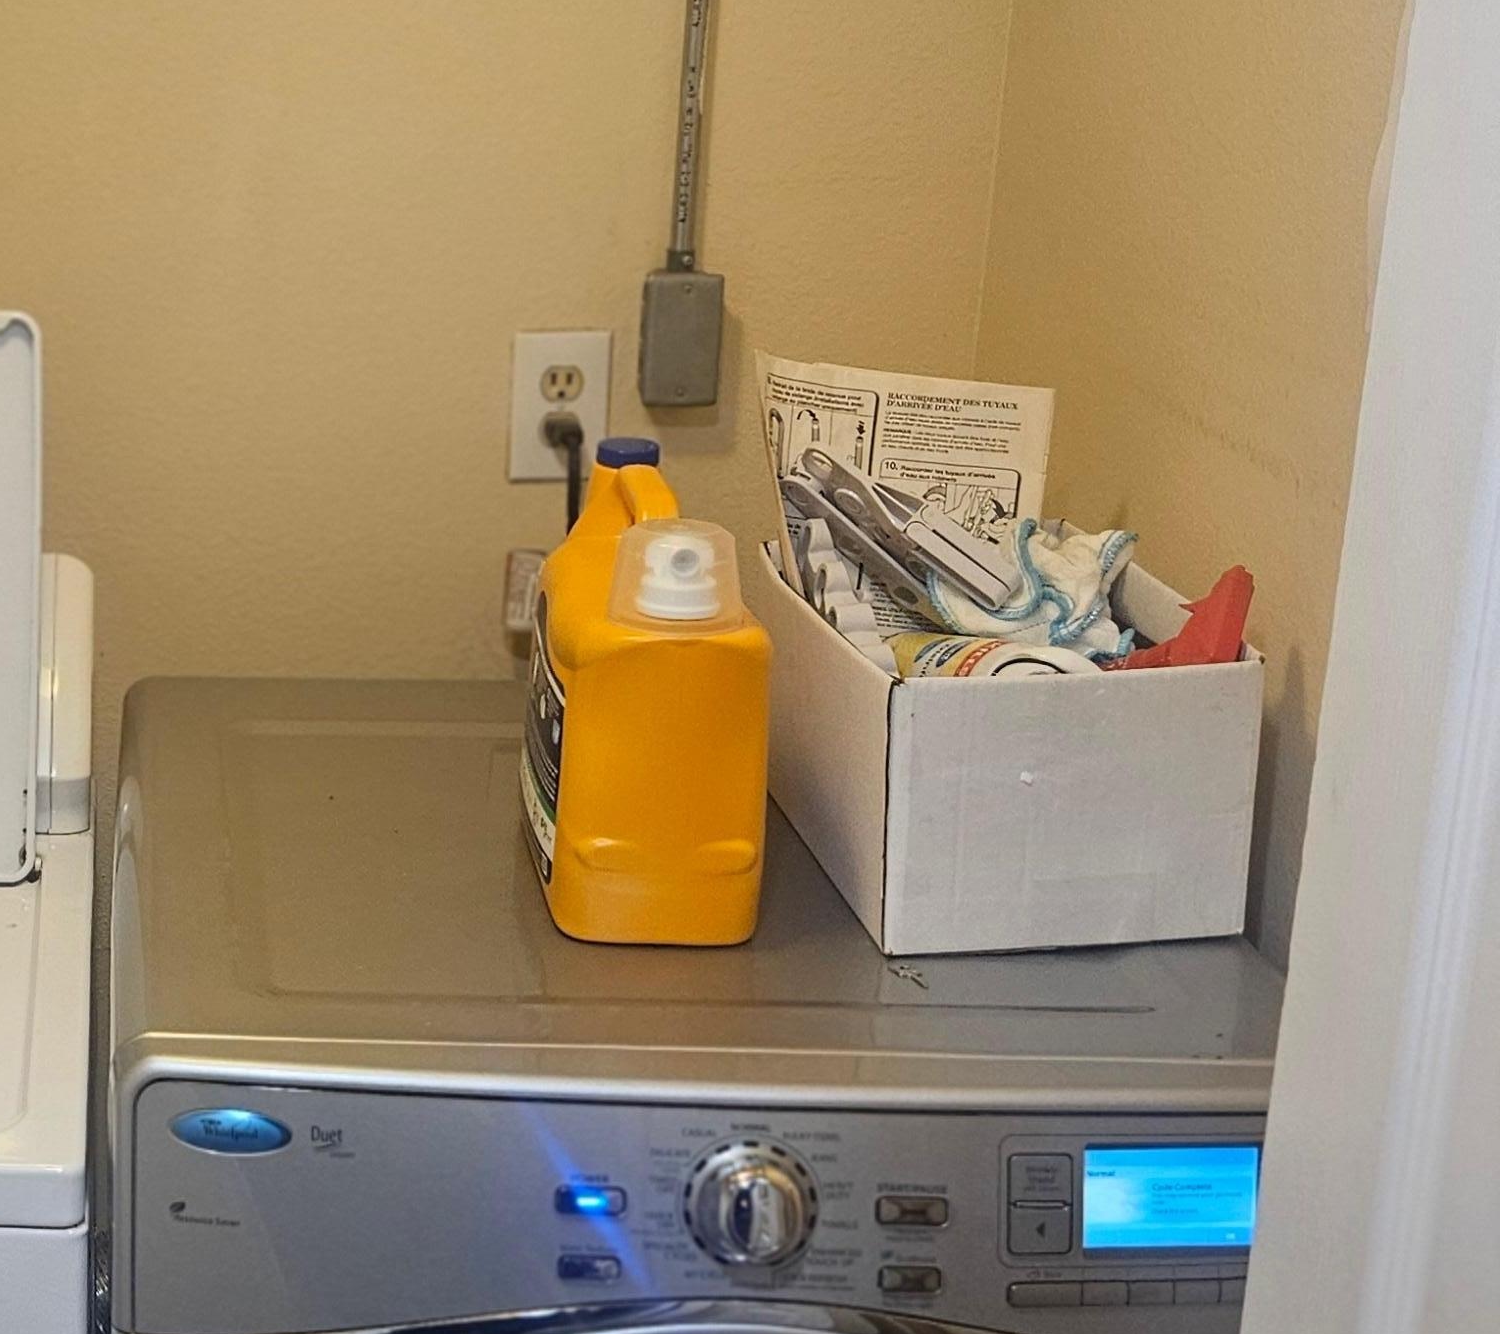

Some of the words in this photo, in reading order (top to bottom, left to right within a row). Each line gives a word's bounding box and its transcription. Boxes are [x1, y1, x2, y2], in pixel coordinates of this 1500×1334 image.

[887, 392, 962, 406] RACCORDEMENT
[962, 399, 981, 407] DES
[982, 400, 1019, 410] TUYAUX
[934, 404, 962, 413] D'EAU
[884, 461, 899, 471] 10.
[201, 1121, 260, 1142] Whirlpool
[310, 1125, 343, 1143] Duet
